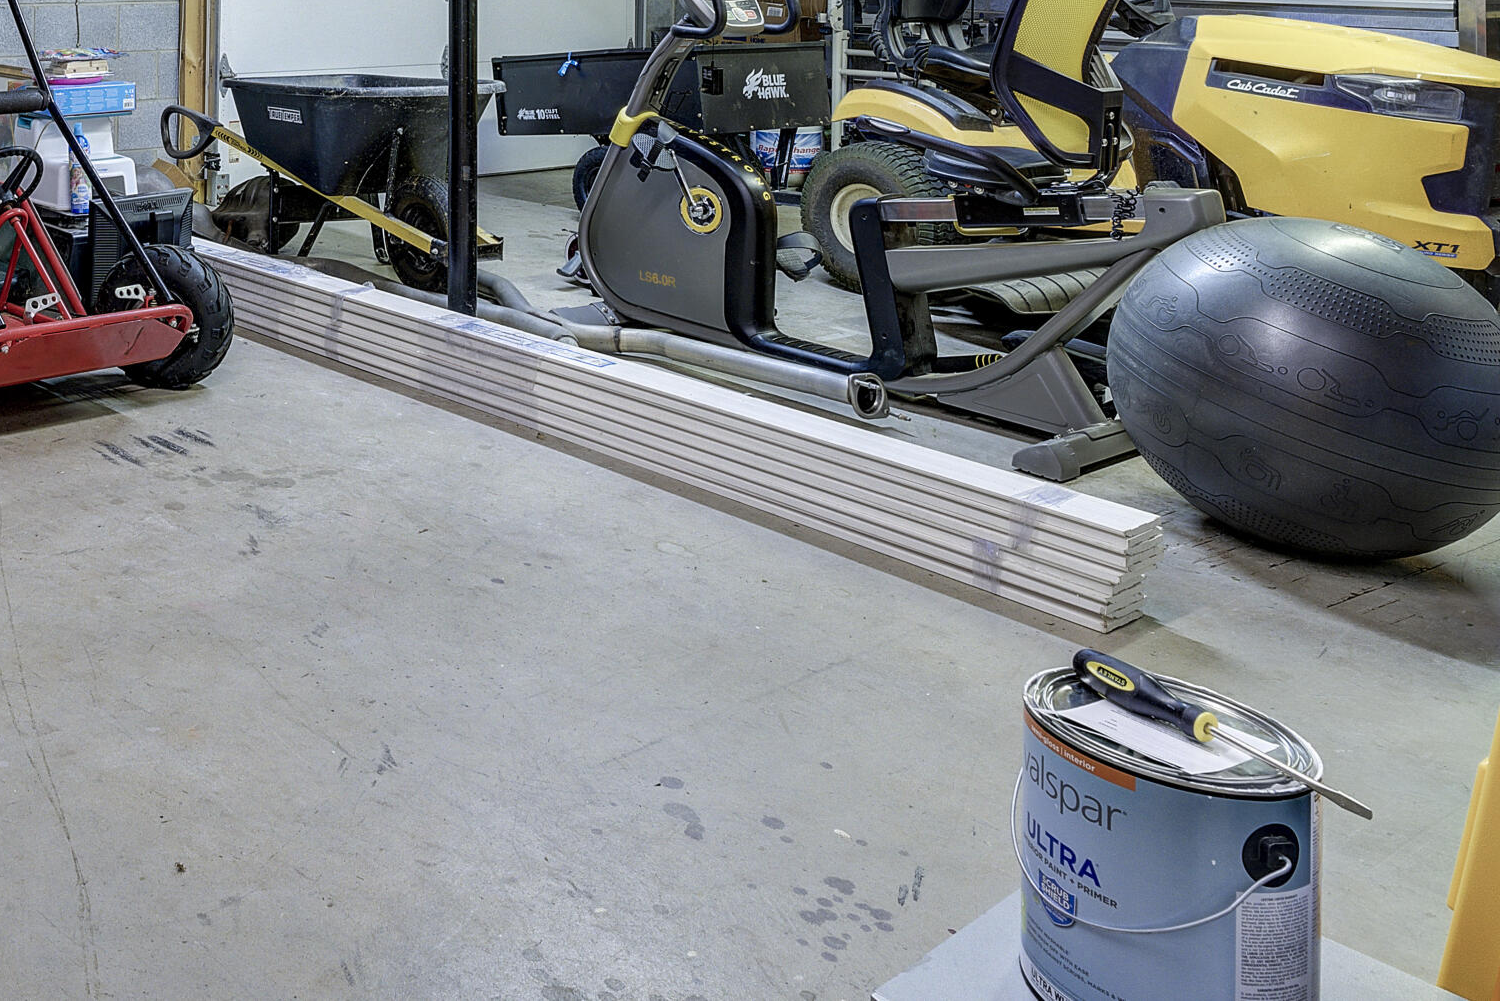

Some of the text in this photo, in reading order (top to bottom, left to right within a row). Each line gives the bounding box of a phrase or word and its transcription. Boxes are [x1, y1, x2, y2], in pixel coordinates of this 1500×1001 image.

[762, 73, 787, 86] BLUE
[1227, 79, 1300, 99] Cub Cadet
[536, 108, 546, 120] 10
[792, 145, 821, 156] hange
[1412, 240, 1460, 254] XT1
[1097, 667, 1127, 687] STANLEY
[1063, 750, 1097, 773] interior
[1027, 810, 1102, 889] ULTRA
[1041, 875, 1070, 901] SCRUB
[1044, 857, 1068, 880] PAINT
[1077, 882, 1119, 910] PRIMER
[1040, 883, 1071, 911] SHIELD
